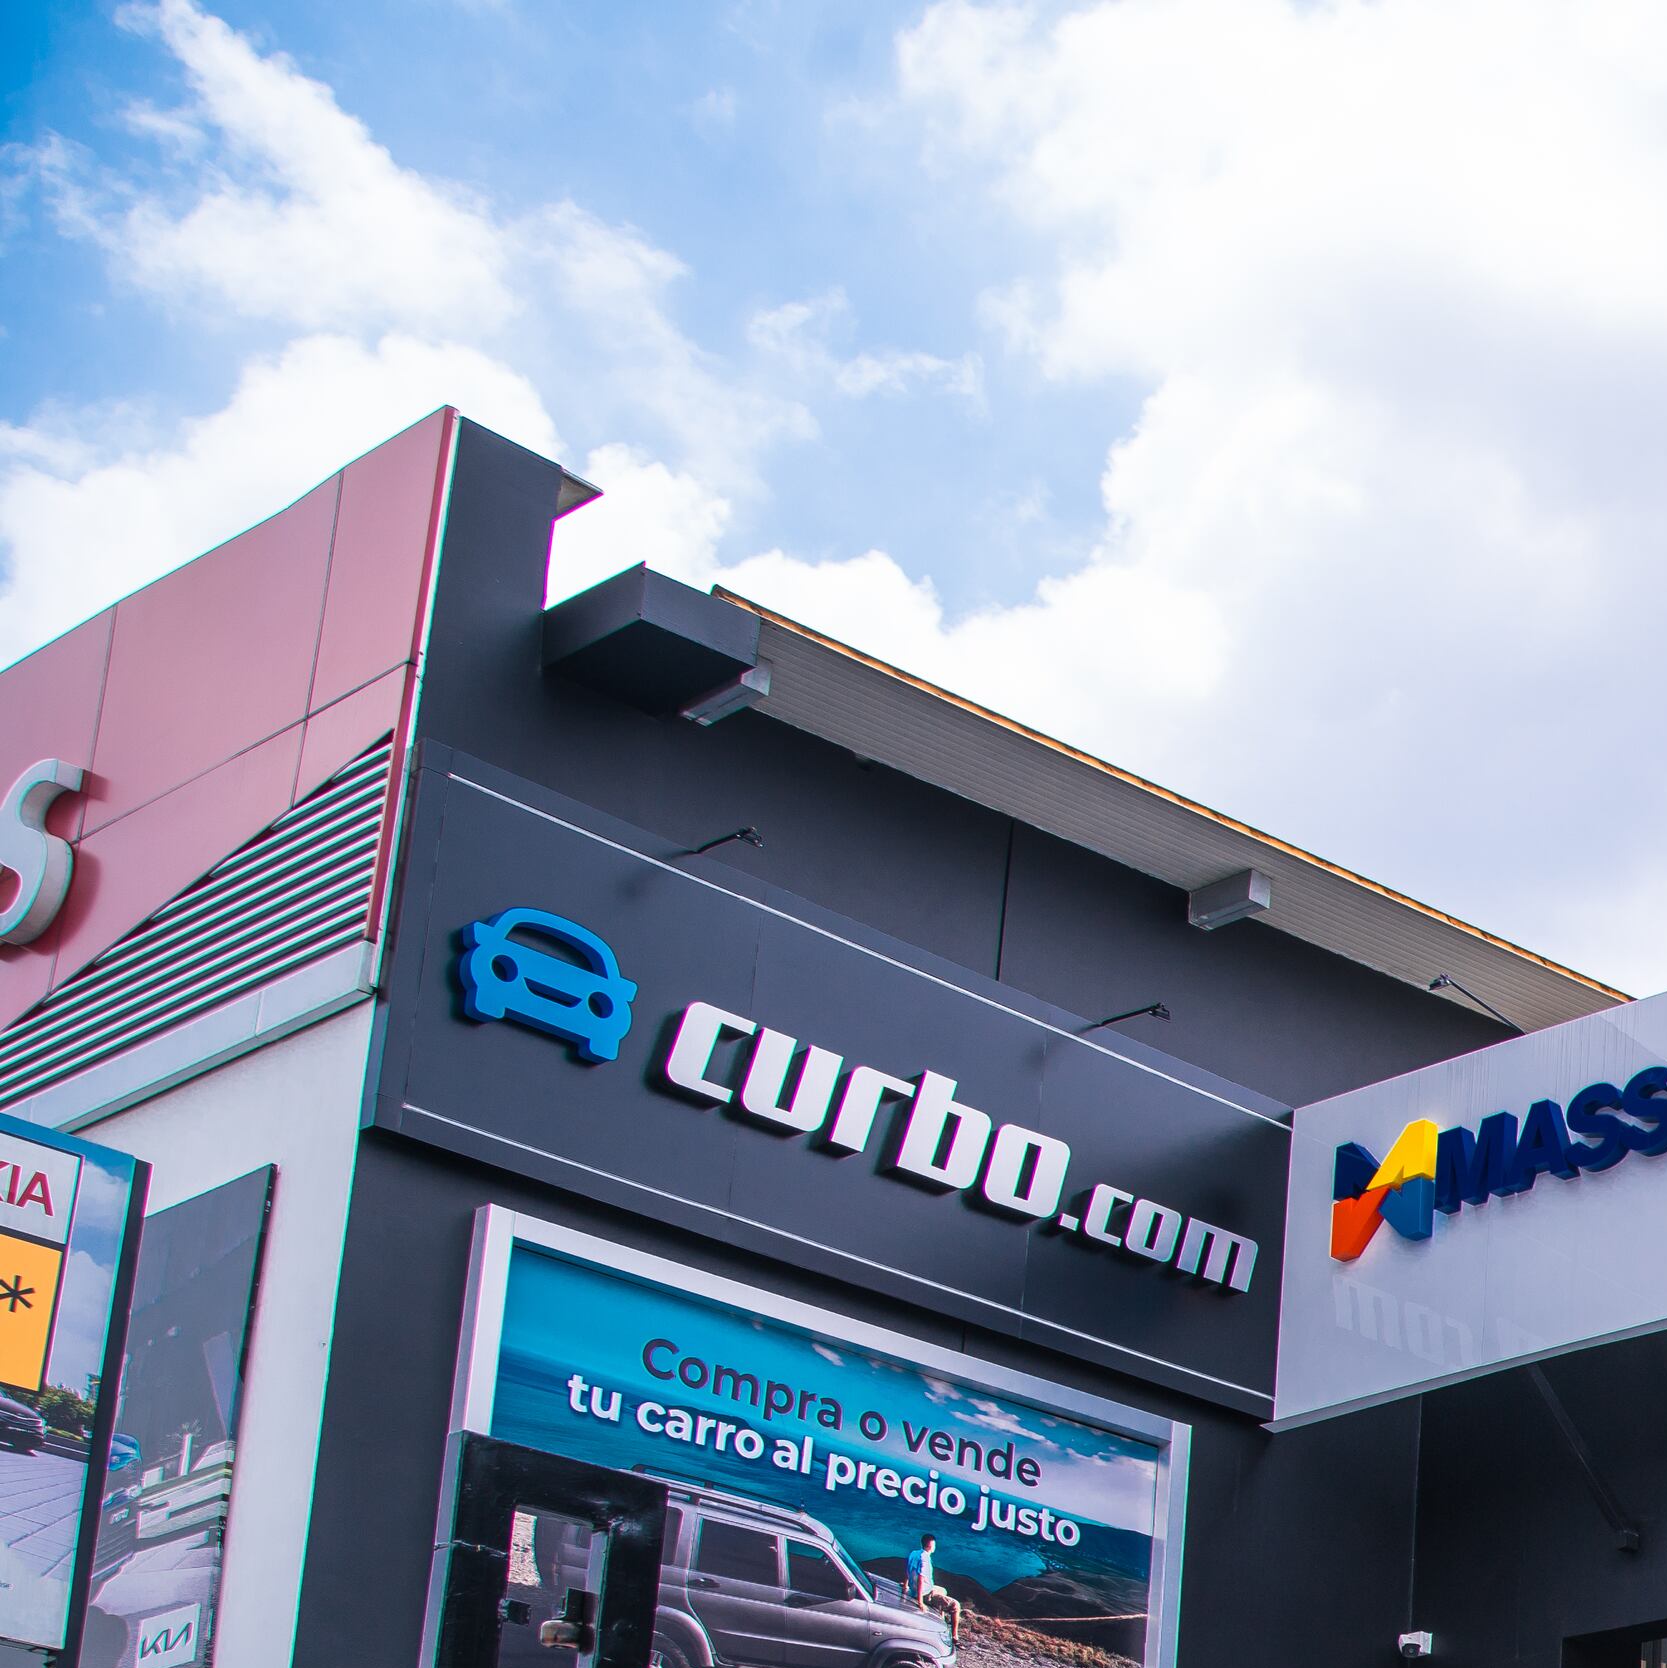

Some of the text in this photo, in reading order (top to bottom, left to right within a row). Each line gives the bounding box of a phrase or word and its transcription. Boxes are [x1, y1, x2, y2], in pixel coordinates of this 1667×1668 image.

[666, 1001, 1260, 1293] curbo.com
[567, 1372, 1081, 1548] tu carro al precio justo
[642, 1338, 1042, 1488] Compra o vende
